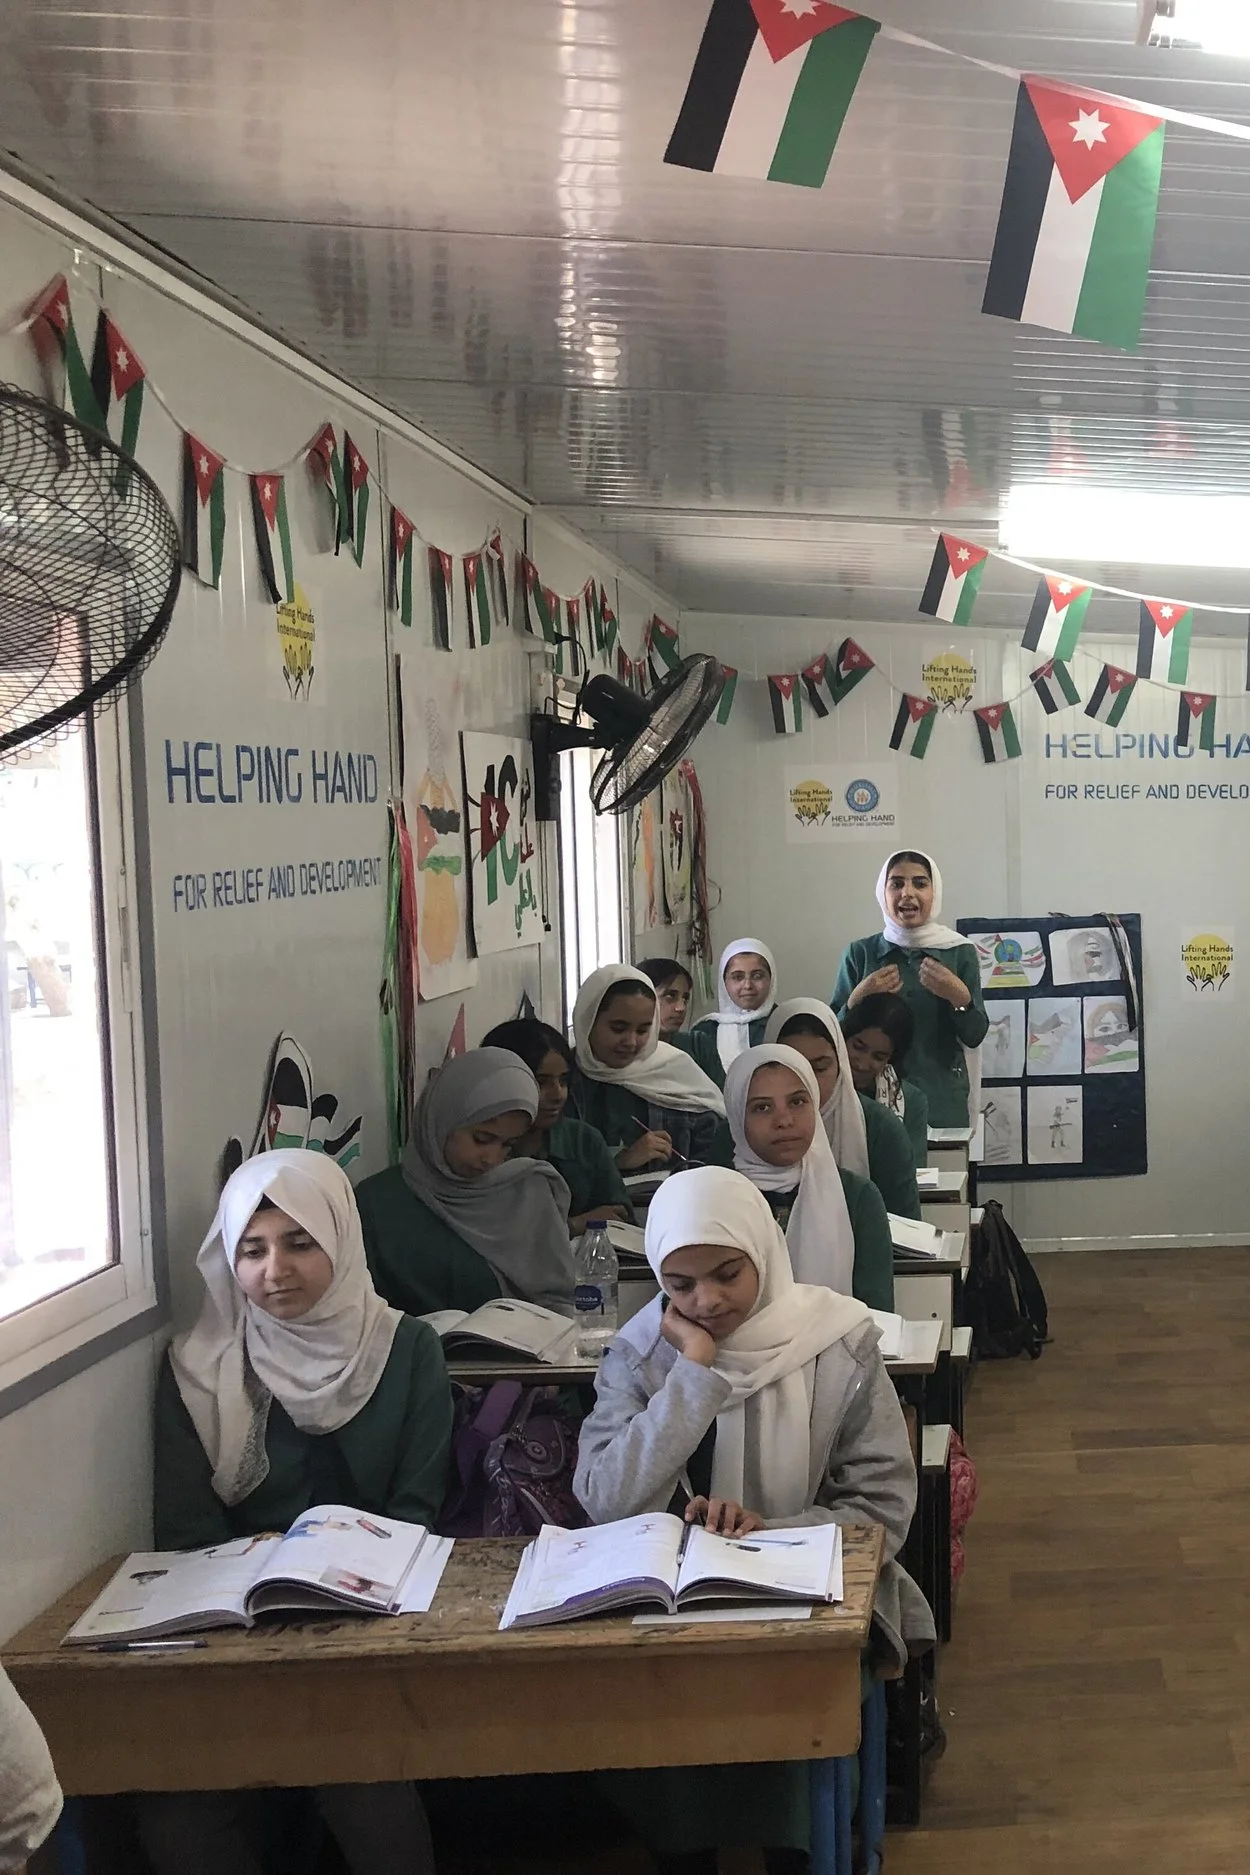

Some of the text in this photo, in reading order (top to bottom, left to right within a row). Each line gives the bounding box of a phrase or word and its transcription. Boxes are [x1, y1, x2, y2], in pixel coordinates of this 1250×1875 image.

[922, 664, 977, 676] Lifting Hands
[922, 673, 977, 684] International
[1044, 732, 1194, 759] HELPING
[165, 739, 378, 804] HELPING HAND
[789, 788, 811, 797] Lifting
[1045, 784, 1078, 799] FOR
[1084, 784, 1141, 799] RELIEF
[1146, 784, 1180, 799] AND
[870, 814, 896, 822] HAND
[173, 857, 382, 912] FOR RELIEF AND DEVELOPMENT
[1181, 944, 1234, 955] Lifting Hands
[1181, 953, 1234, 961] International
